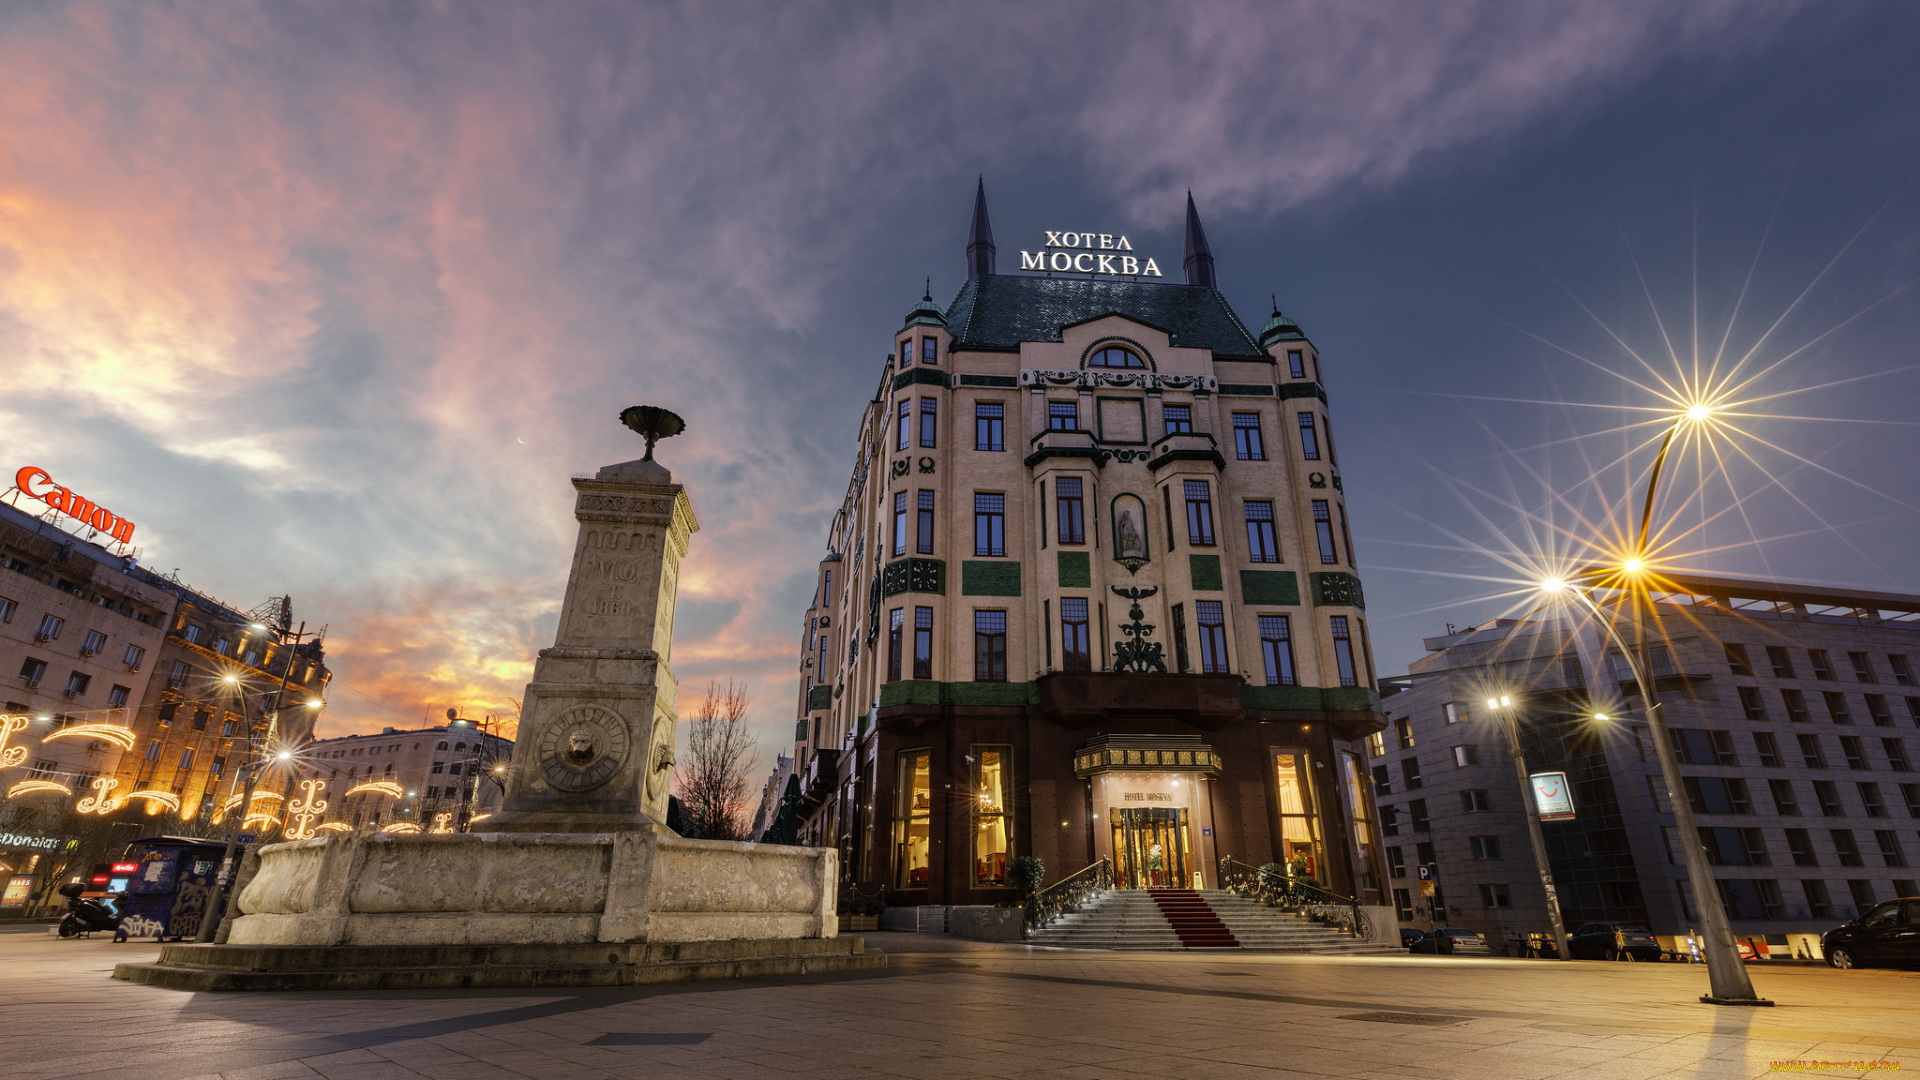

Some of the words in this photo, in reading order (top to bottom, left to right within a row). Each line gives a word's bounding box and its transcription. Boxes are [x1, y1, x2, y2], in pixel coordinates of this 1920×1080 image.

[1045, 231, 1132, 250] ХОТЕЛ
[1020, 251, 1162, 277] МОСКВА
[16, 466, 135, 544] Canon
[1124, 792, 1145, 801] HOTEL
[1419, 867, 1428, 879] P
